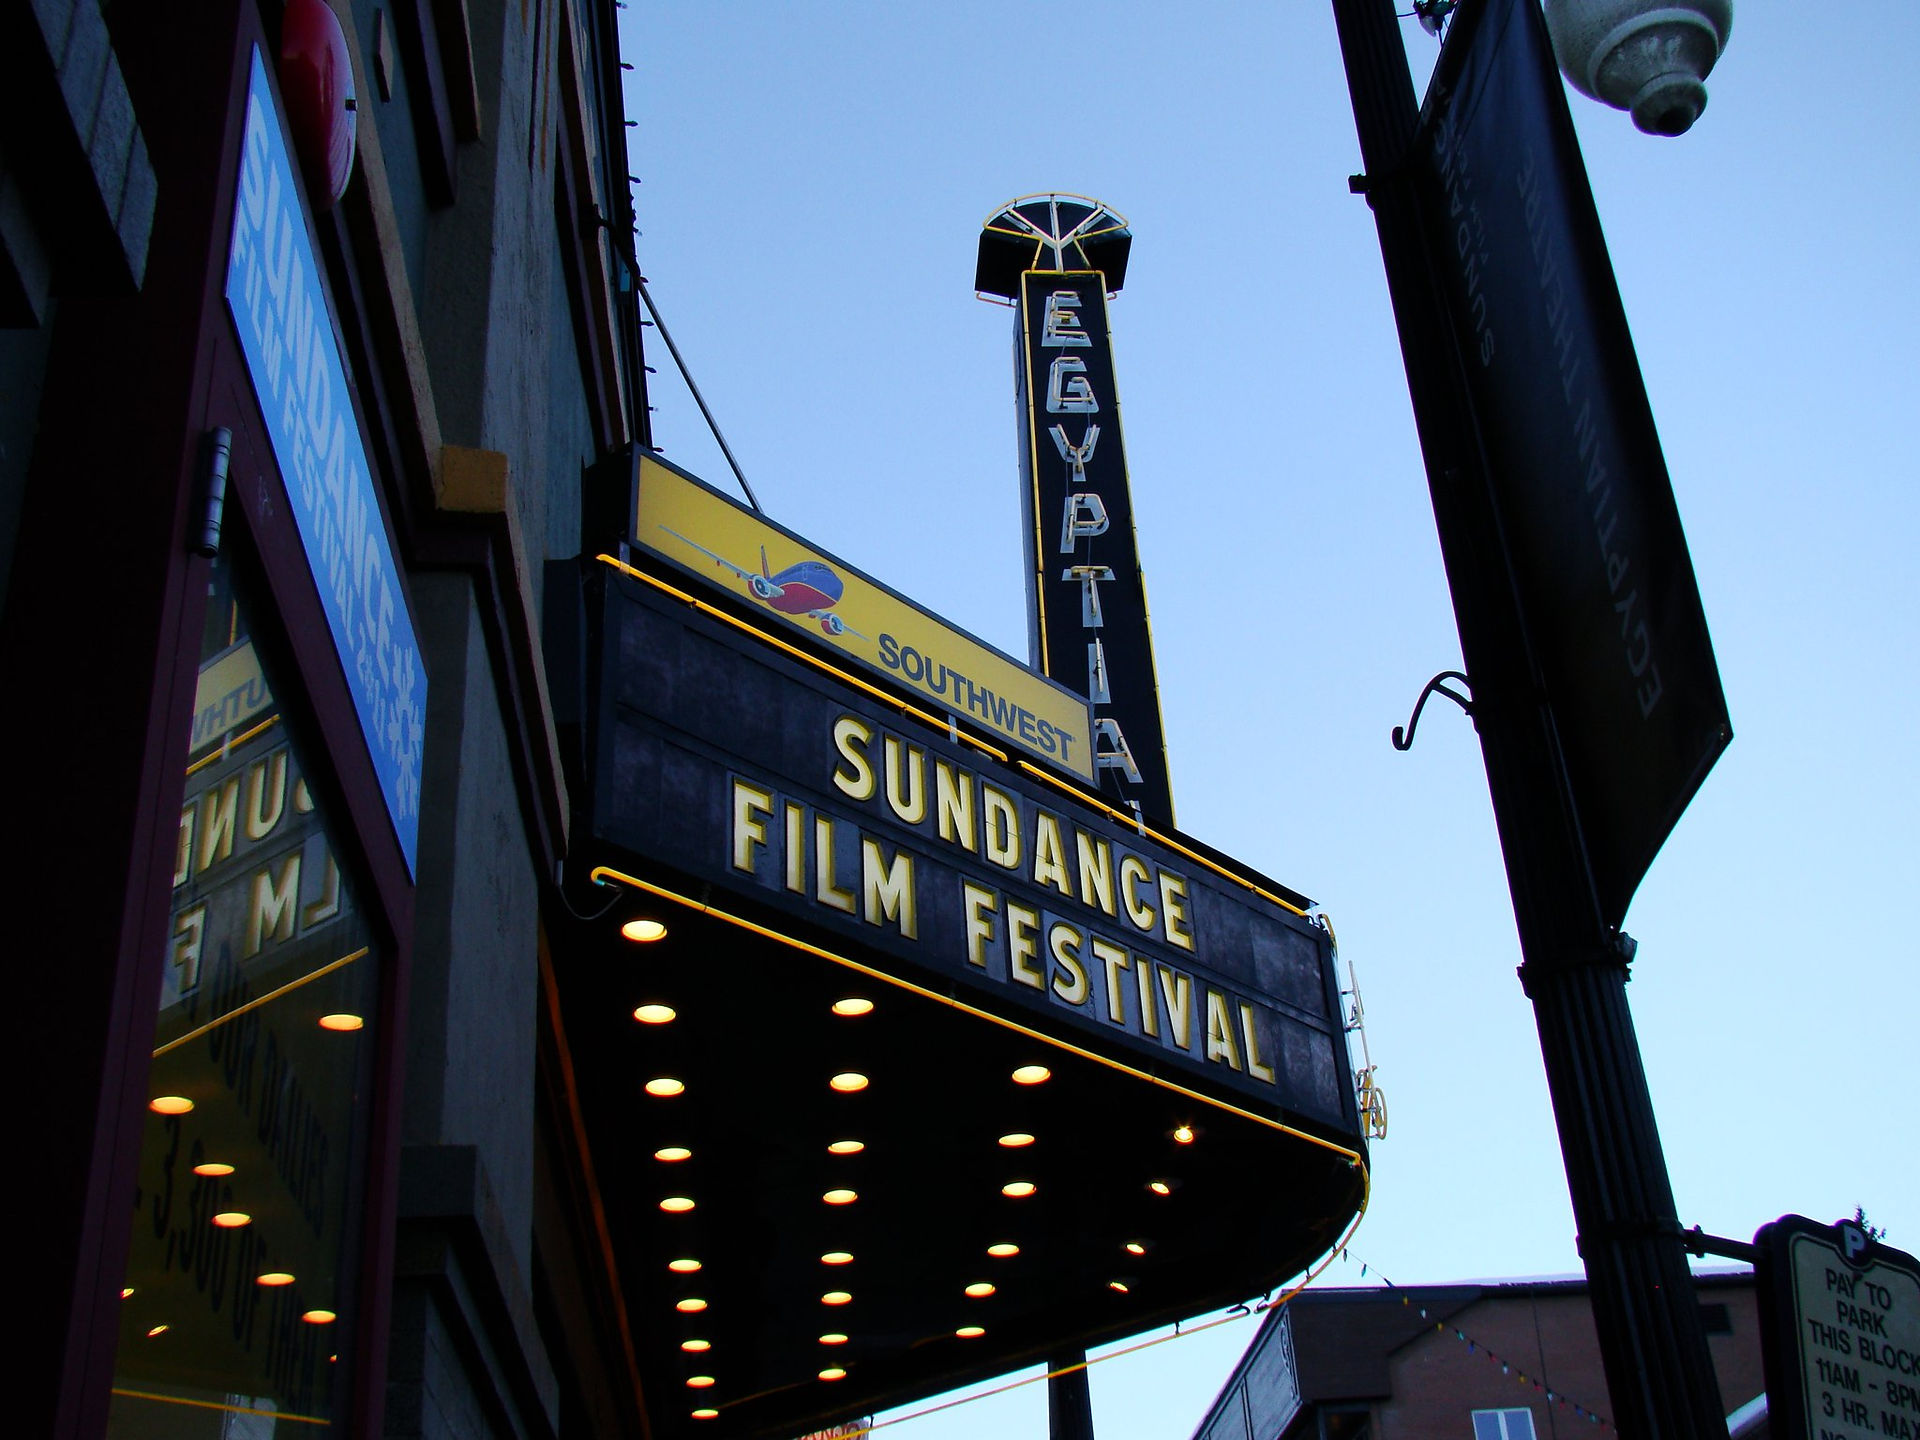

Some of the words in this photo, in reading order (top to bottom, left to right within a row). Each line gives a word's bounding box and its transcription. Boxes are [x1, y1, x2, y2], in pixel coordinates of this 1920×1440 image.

[233, 197, 282, 401] FILM
[282, 372, 355, 652] FESTIVAL
[243, 93, 394, 690] SUNDANCE
[1041, 289, 1144, 838] EGYPTIA
[1571, 396, 1664, 721] EGYPTIAN
[878, 633, 1073, 762] SOUTHWEST
[832, 715, 1196, 953] SUNDANCE
[732, 778, 918, 940] FILM
[963, 881, 1275, 1085] FESTIVAL
[1825, 1267, 1864, 1300] PAY
[1864, 1280, 1892, 1311] TO
[1843, 1224, 1866, 1259] P
[1807, 1318, 1851, 1355] THIS
[1857, 1335, 1920, 1377] BLOCK
[1815, 1357, 1862, 1394] 11AM
[1836, 1300, 1889, 1339] PARK
[1822, 1390, 1835, 1418] 3
[1841, 1398, 1875, 1431] HR.
